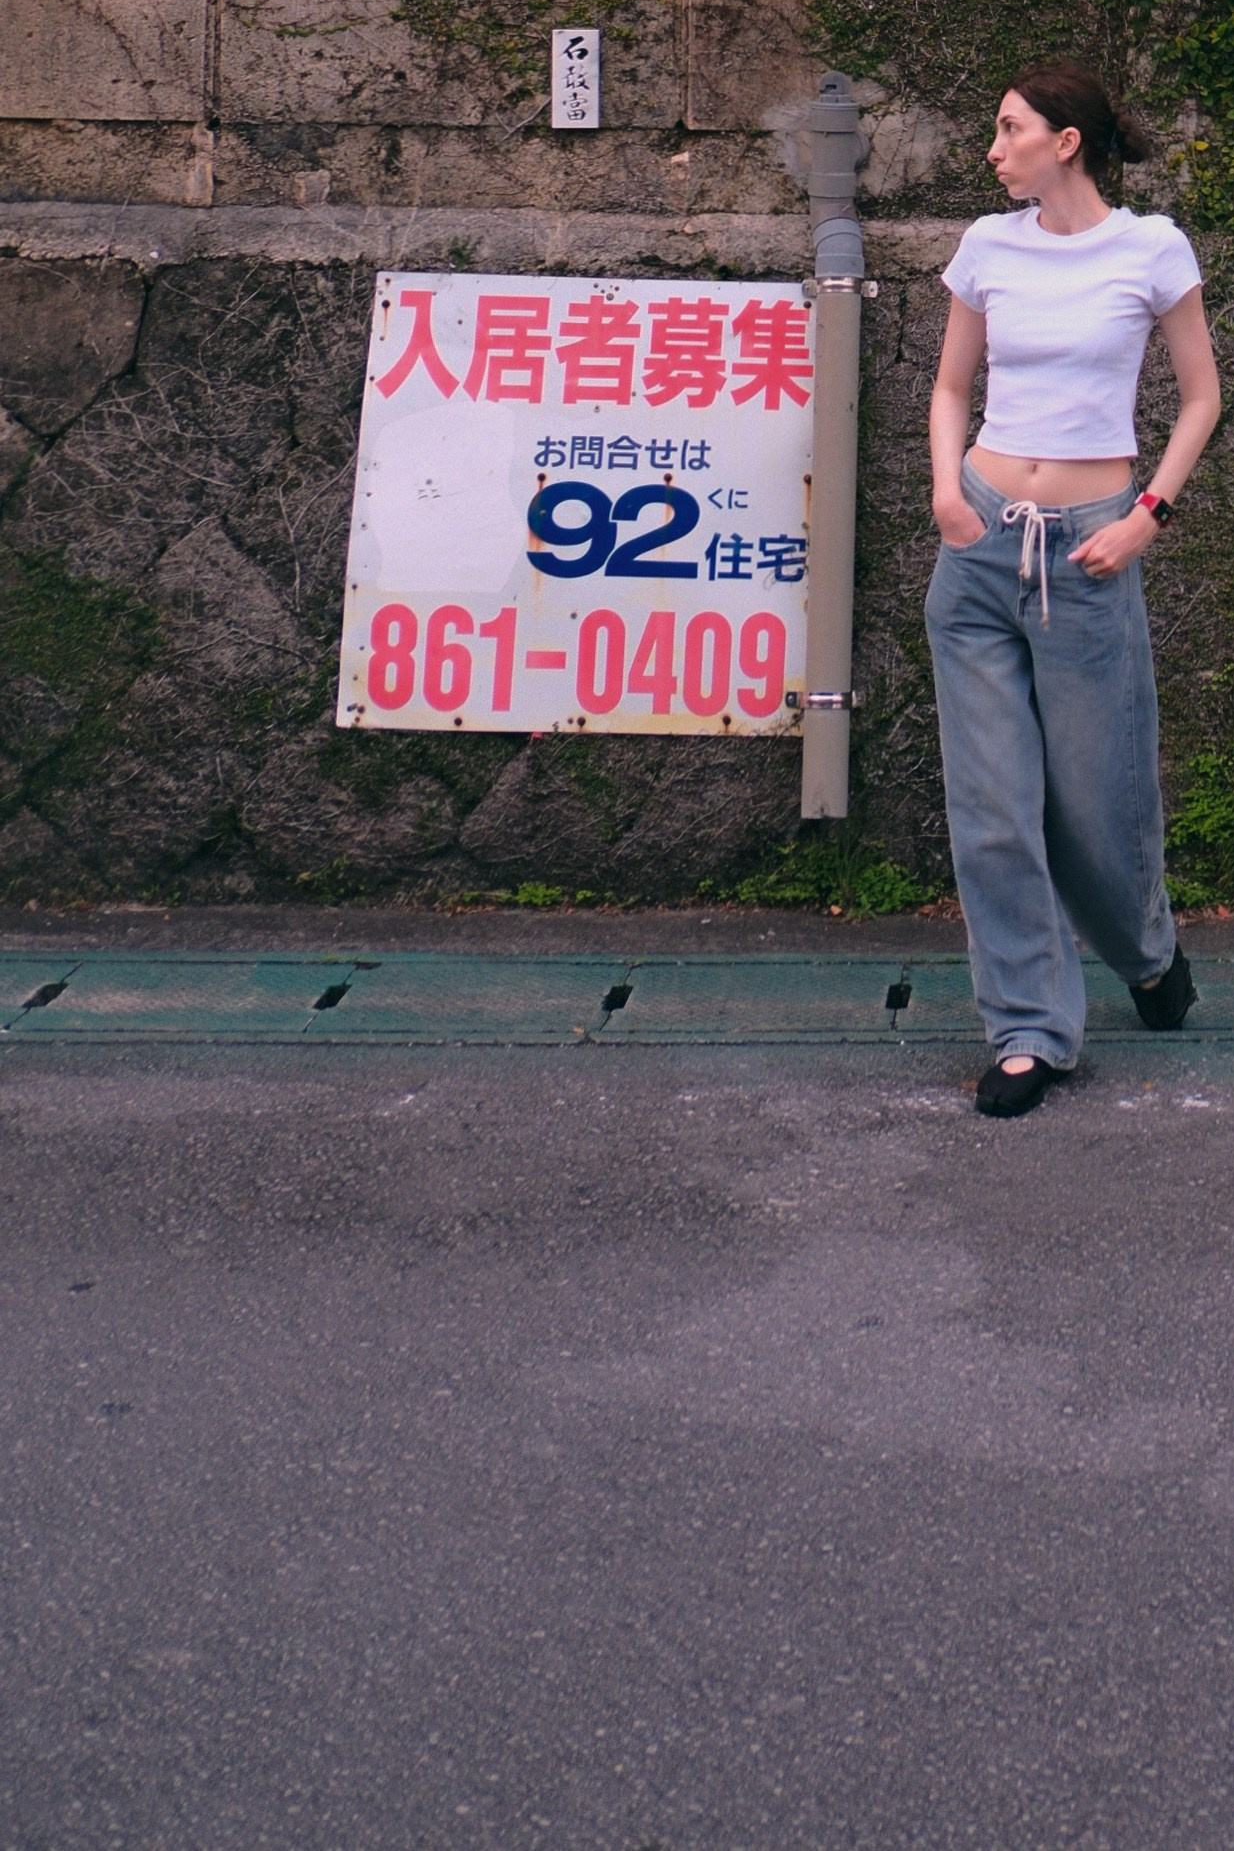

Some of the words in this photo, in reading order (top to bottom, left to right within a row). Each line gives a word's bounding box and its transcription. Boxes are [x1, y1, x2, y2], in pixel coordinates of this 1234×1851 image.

[375, 290, 815, 410] 入居者募集
[533, 435, 712, 471] お問合せは
[706, 488, 749, 510] くに
[367, 603, 787, 718] 861-0409
